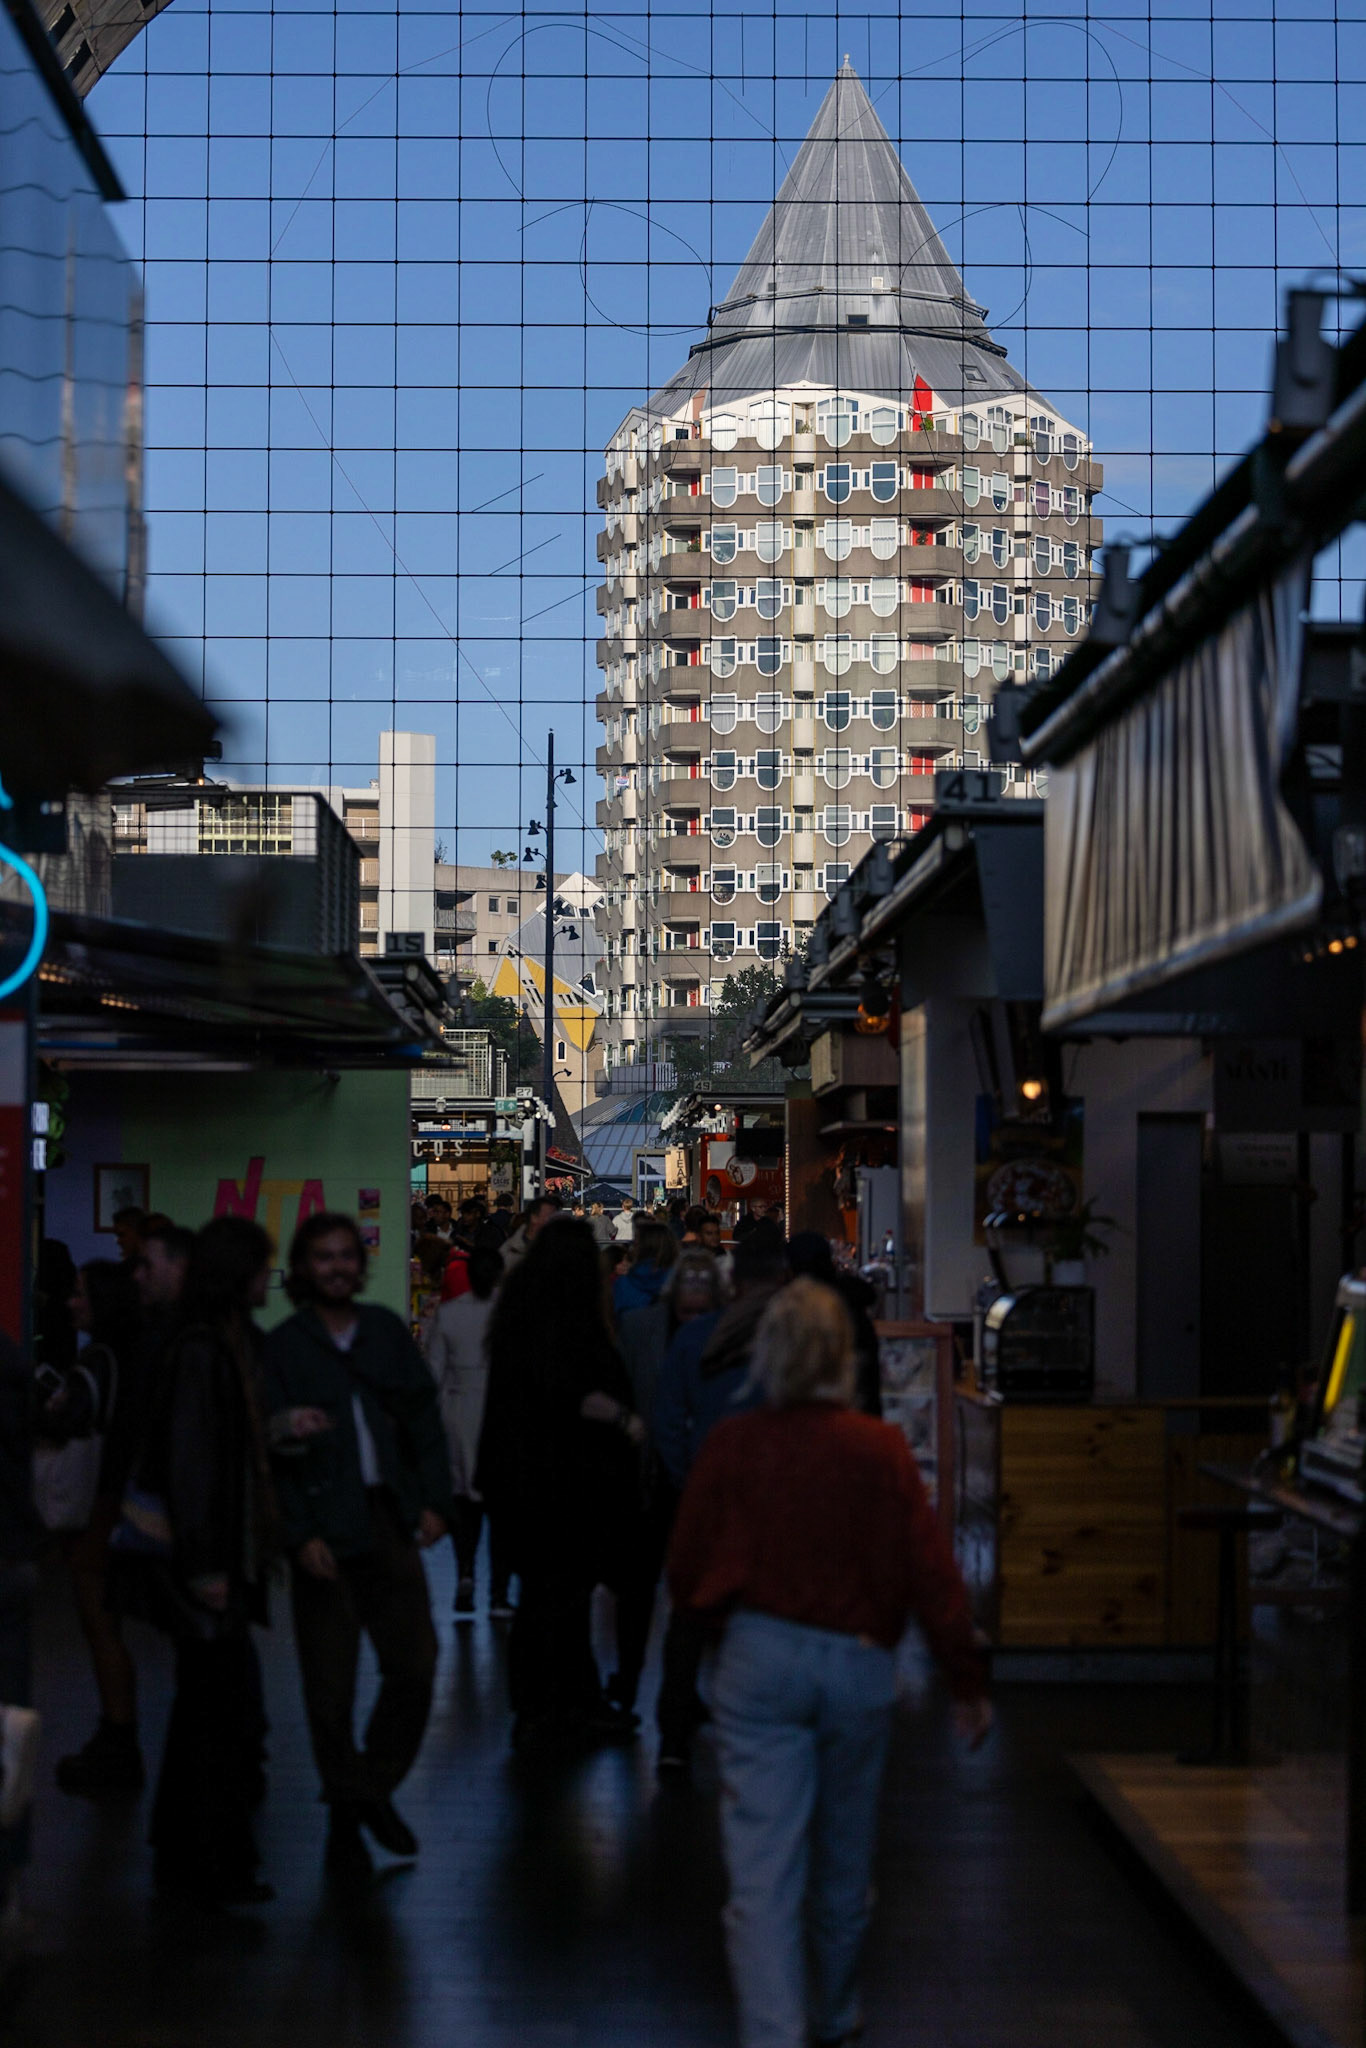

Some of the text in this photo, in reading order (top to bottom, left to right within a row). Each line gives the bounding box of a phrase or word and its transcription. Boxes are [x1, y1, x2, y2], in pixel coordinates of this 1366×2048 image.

[943, 774, 997, 802] 41
[695, 1081, 710, 1091] 49
[517, 1088, 531, 1097] 27
